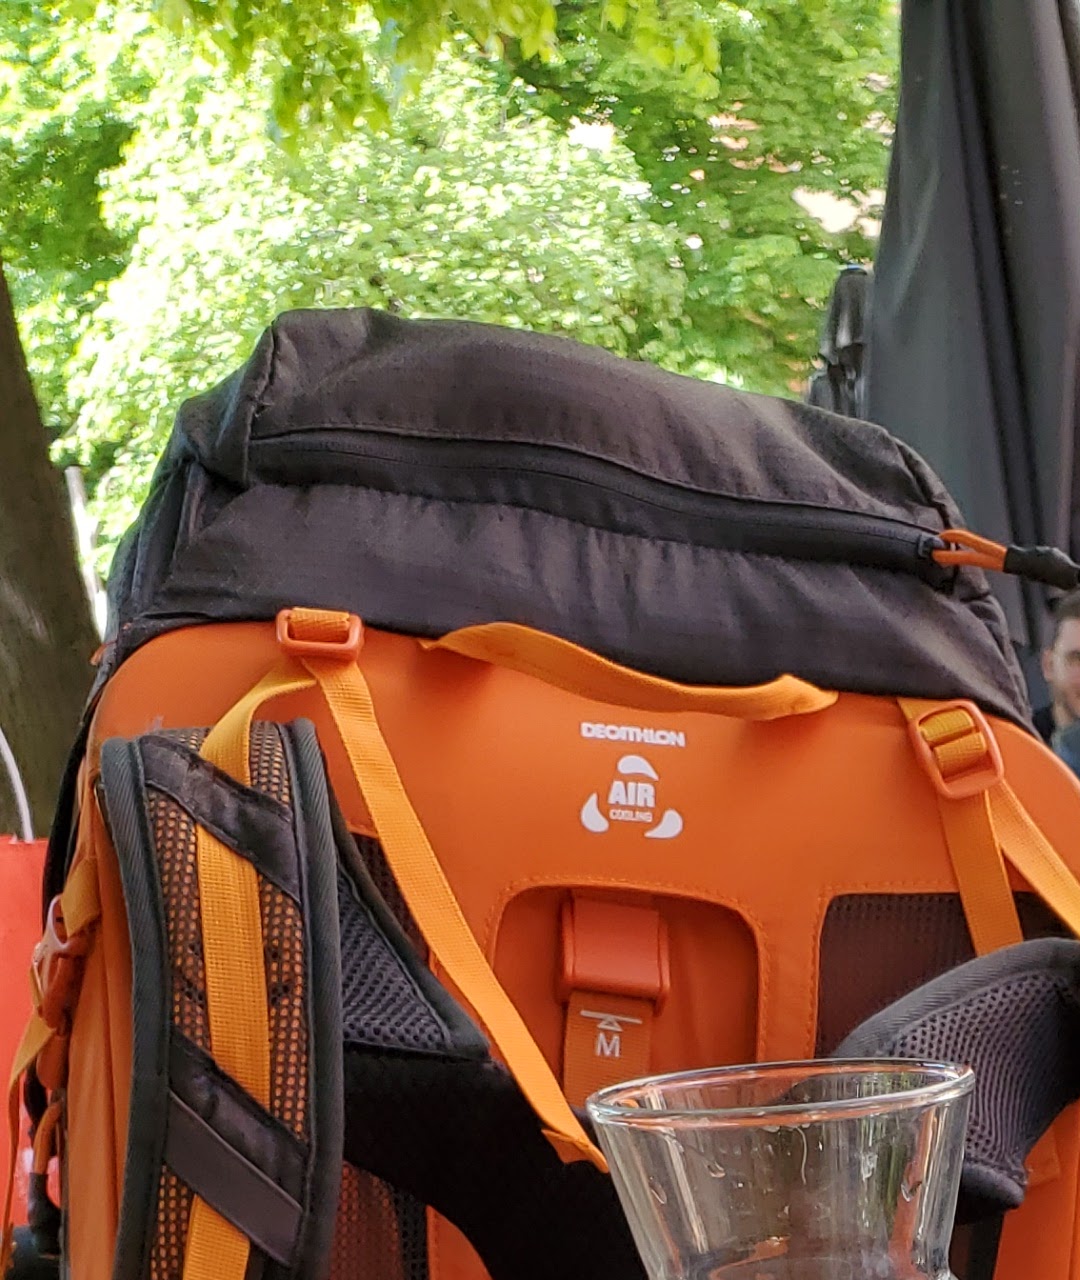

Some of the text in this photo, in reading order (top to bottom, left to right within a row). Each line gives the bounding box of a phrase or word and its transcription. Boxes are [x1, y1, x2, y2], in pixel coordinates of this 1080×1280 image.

[580, 721, 686, 747] DECATHLON
[608, 780, 656, 808] AIR
[595, 1031, 622, 1058] M
